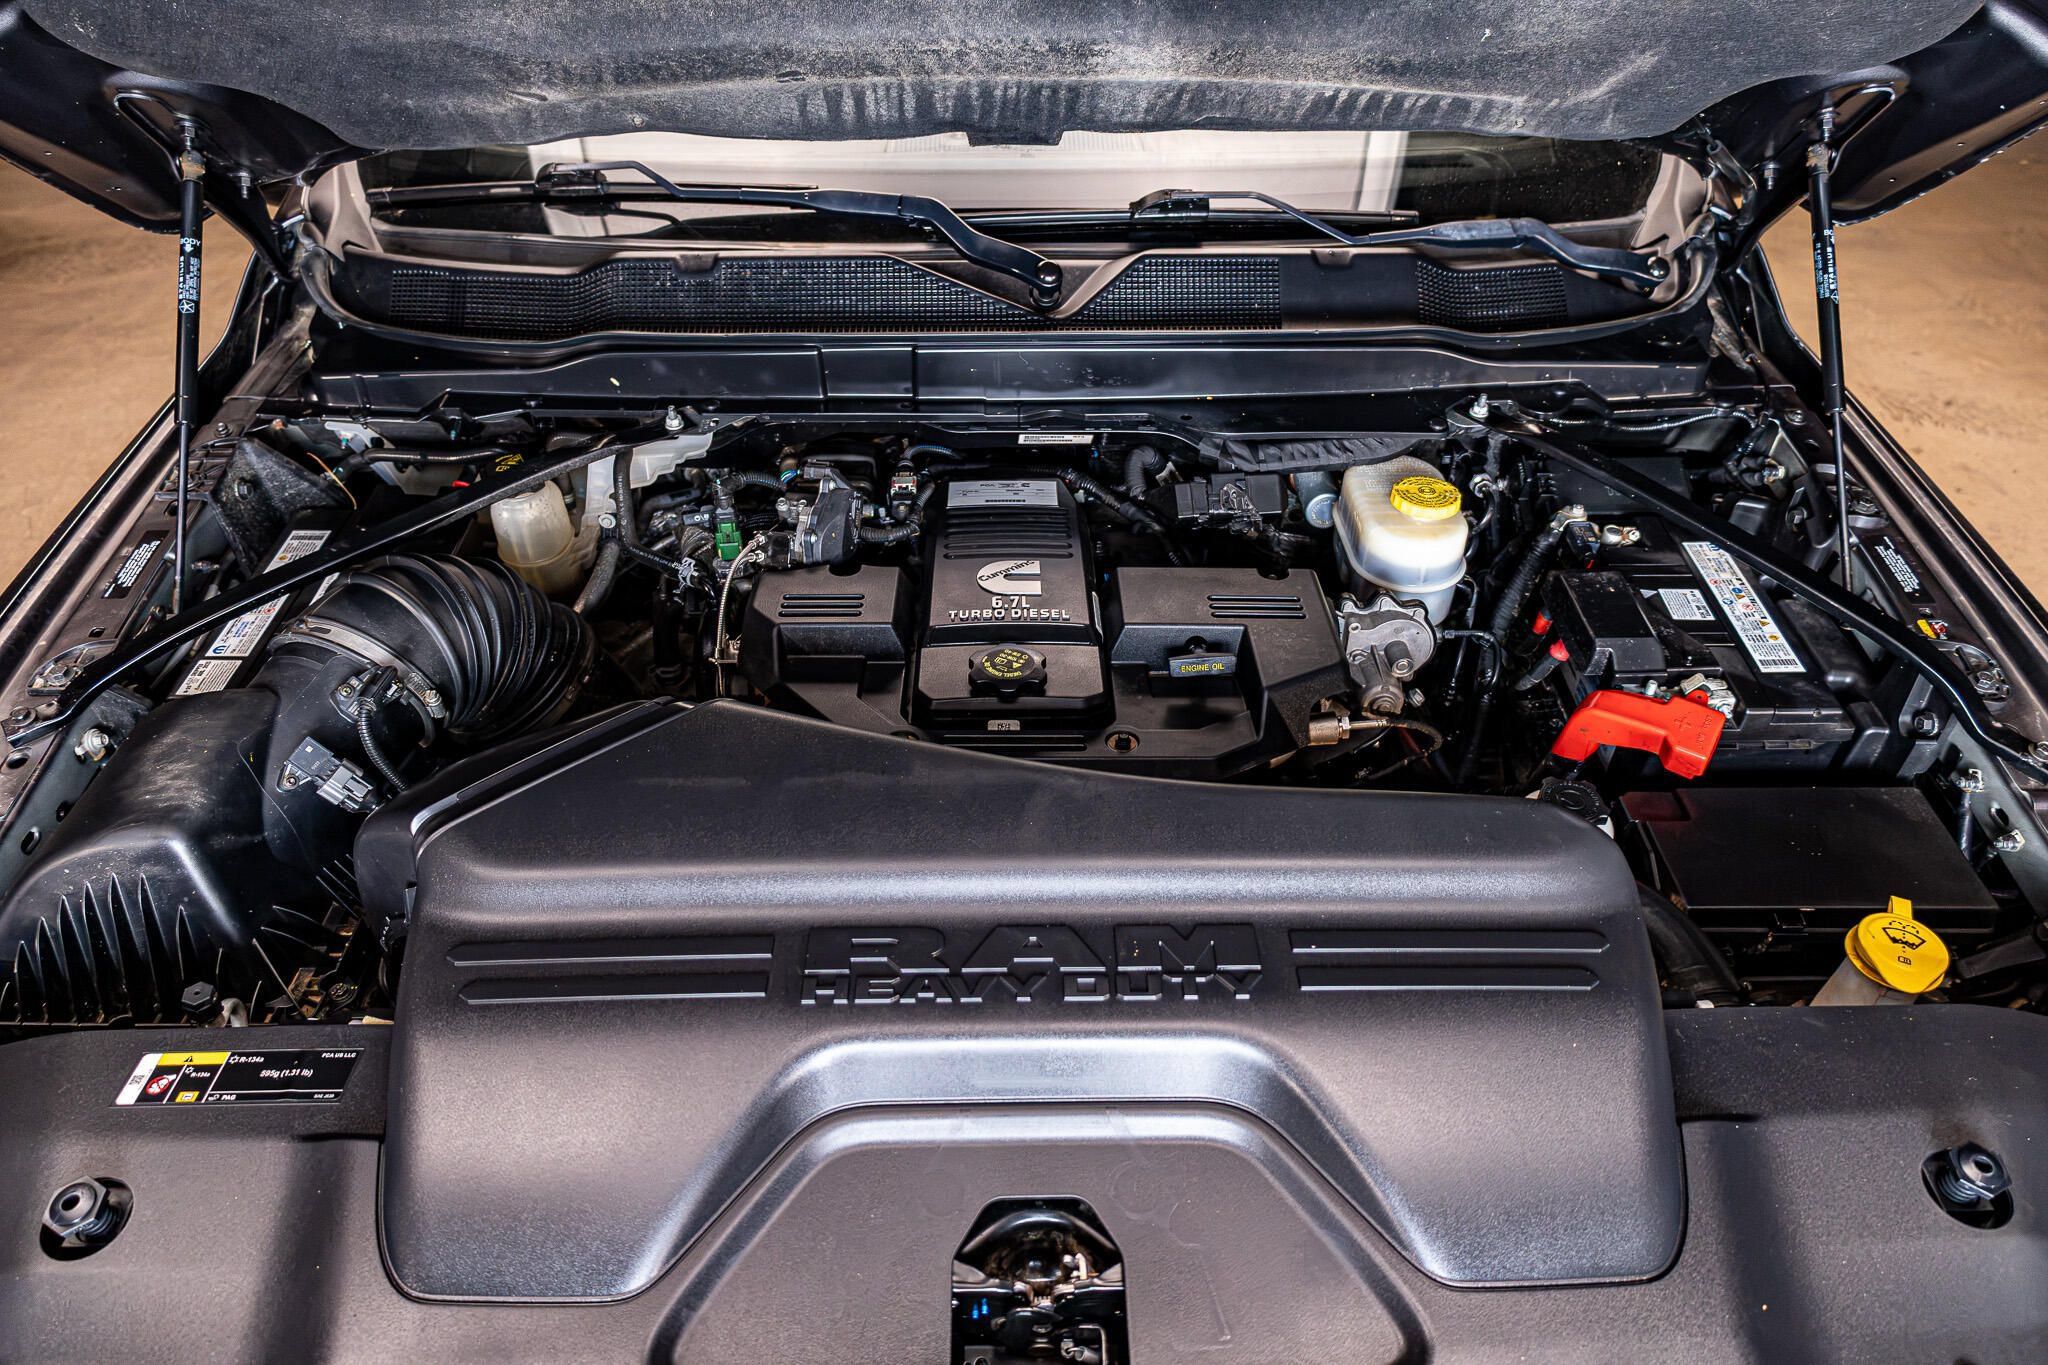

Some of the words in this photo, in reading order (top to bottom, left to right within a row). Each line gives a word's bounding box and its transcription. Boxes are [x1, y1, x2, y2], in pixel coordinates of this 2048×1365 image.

[991, 595, 1031, 608] 6.7L
[948, 609, 1005, 620] TURBO
[1011, 609, 1071, 620] DIESEL
[1181, 663, 1210, 673] ENGINE
[1211, 662, 1225, 670] OIL
[803, 922, 1262, 974] RAM
[800, 973, 1050, 1005] HEAVY
[1063, 971, 1264, 1002] DUTY
[259, 1069, 280, 1078] 595g
[281, 1069, 300, 1077] (1.31
[301, 1068, 313, 1077] lb)
